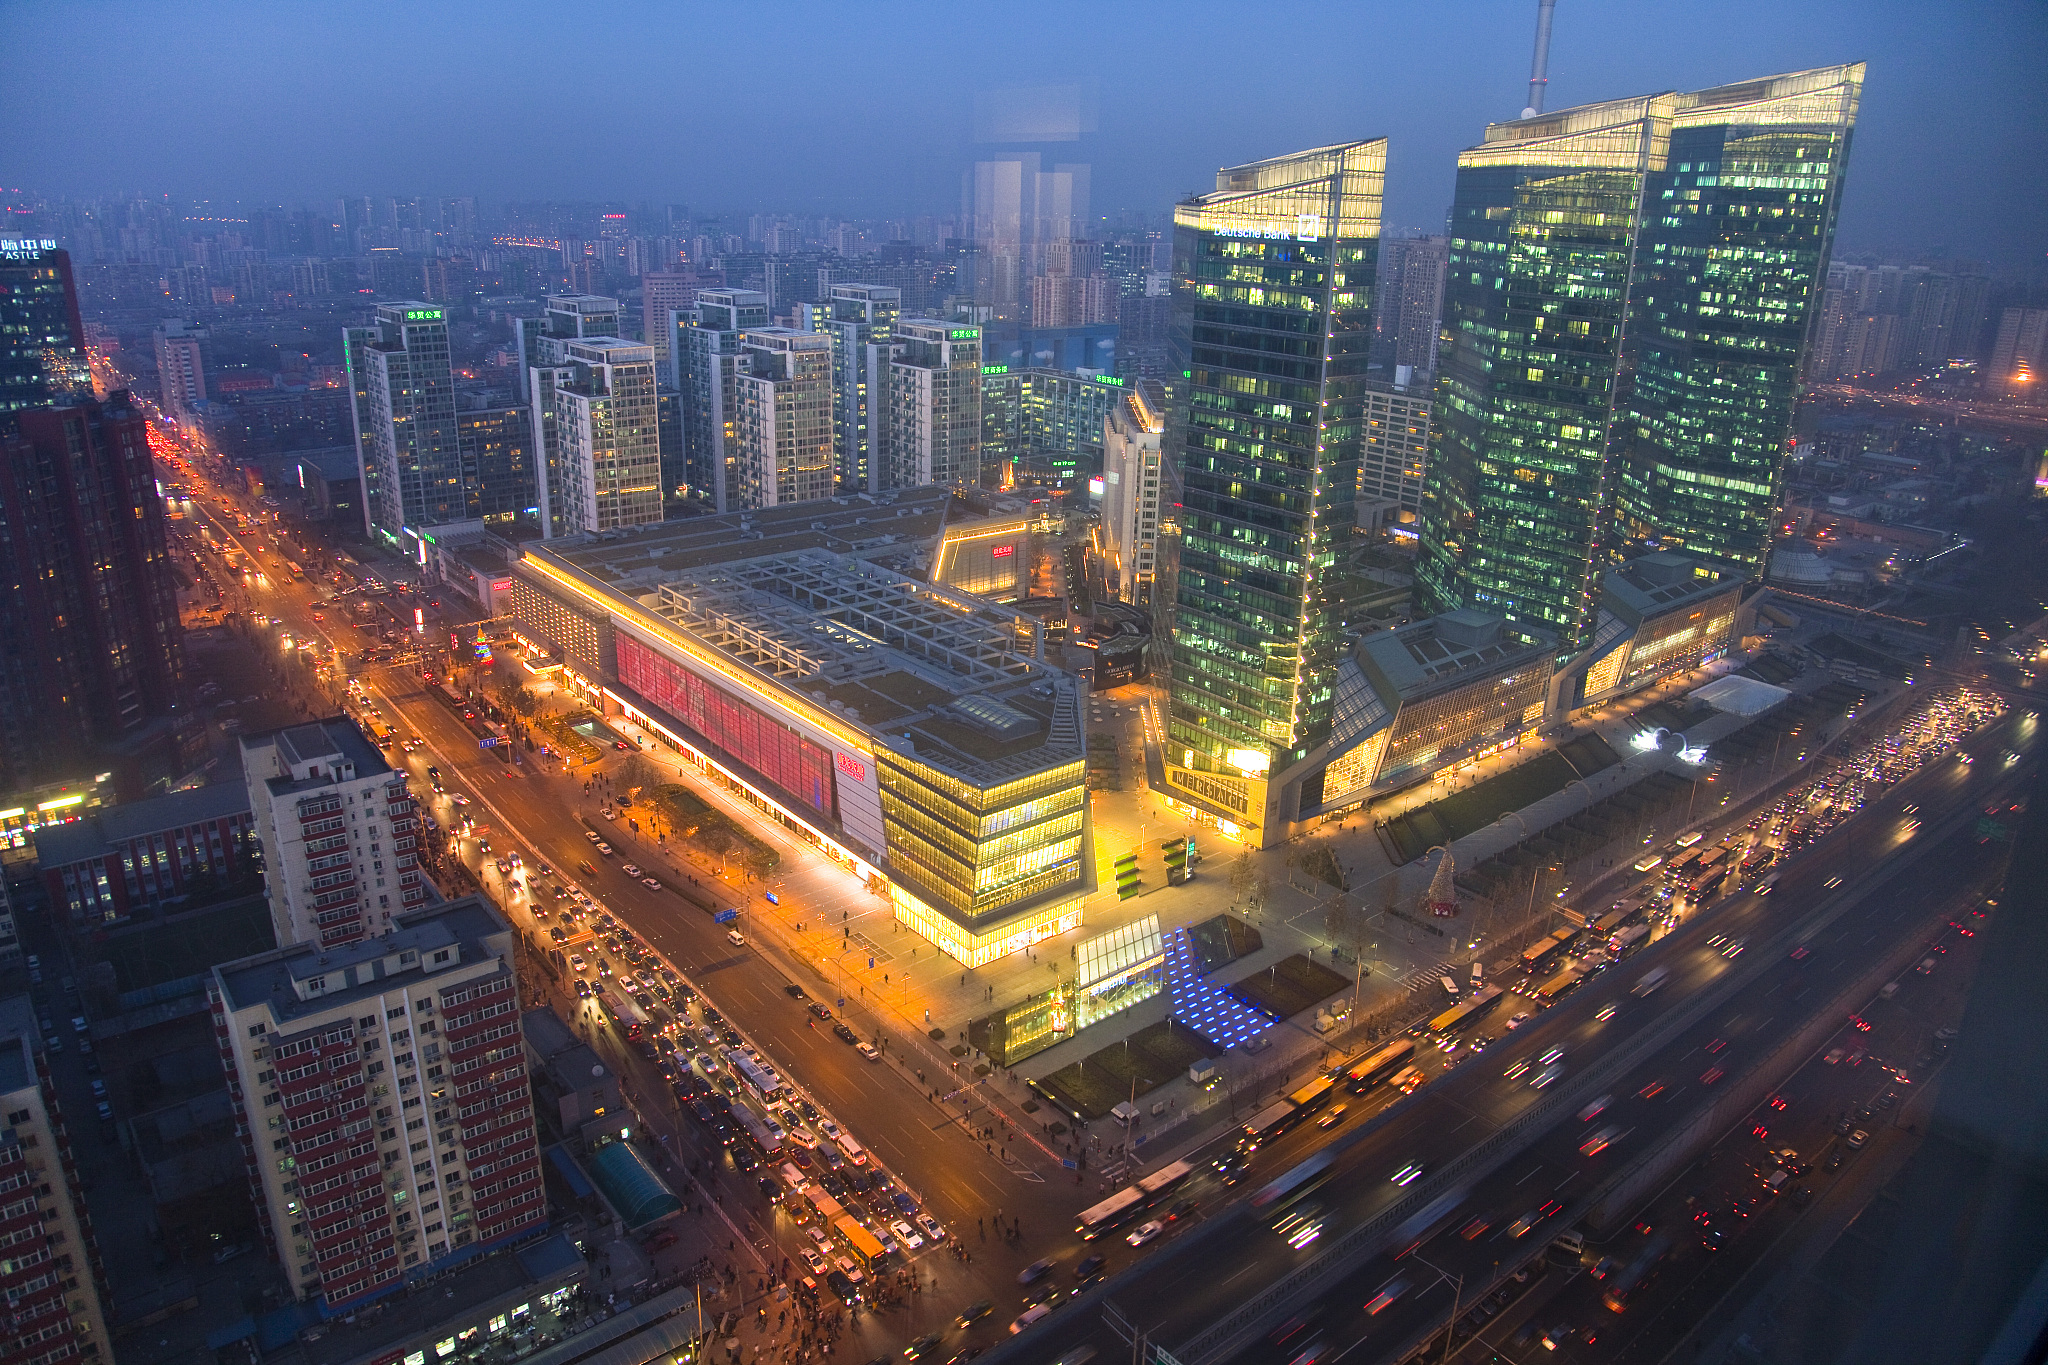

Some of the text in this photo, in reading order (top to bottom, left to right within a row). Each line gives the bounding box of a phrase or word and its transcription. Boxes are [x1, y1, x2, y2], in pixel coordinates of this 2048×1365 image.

[1214, 226, 1291, 240] Deutsche Bank
[0, 251, 40, 260] ASTLE
[925, 908, 961, 939] GUCCI
